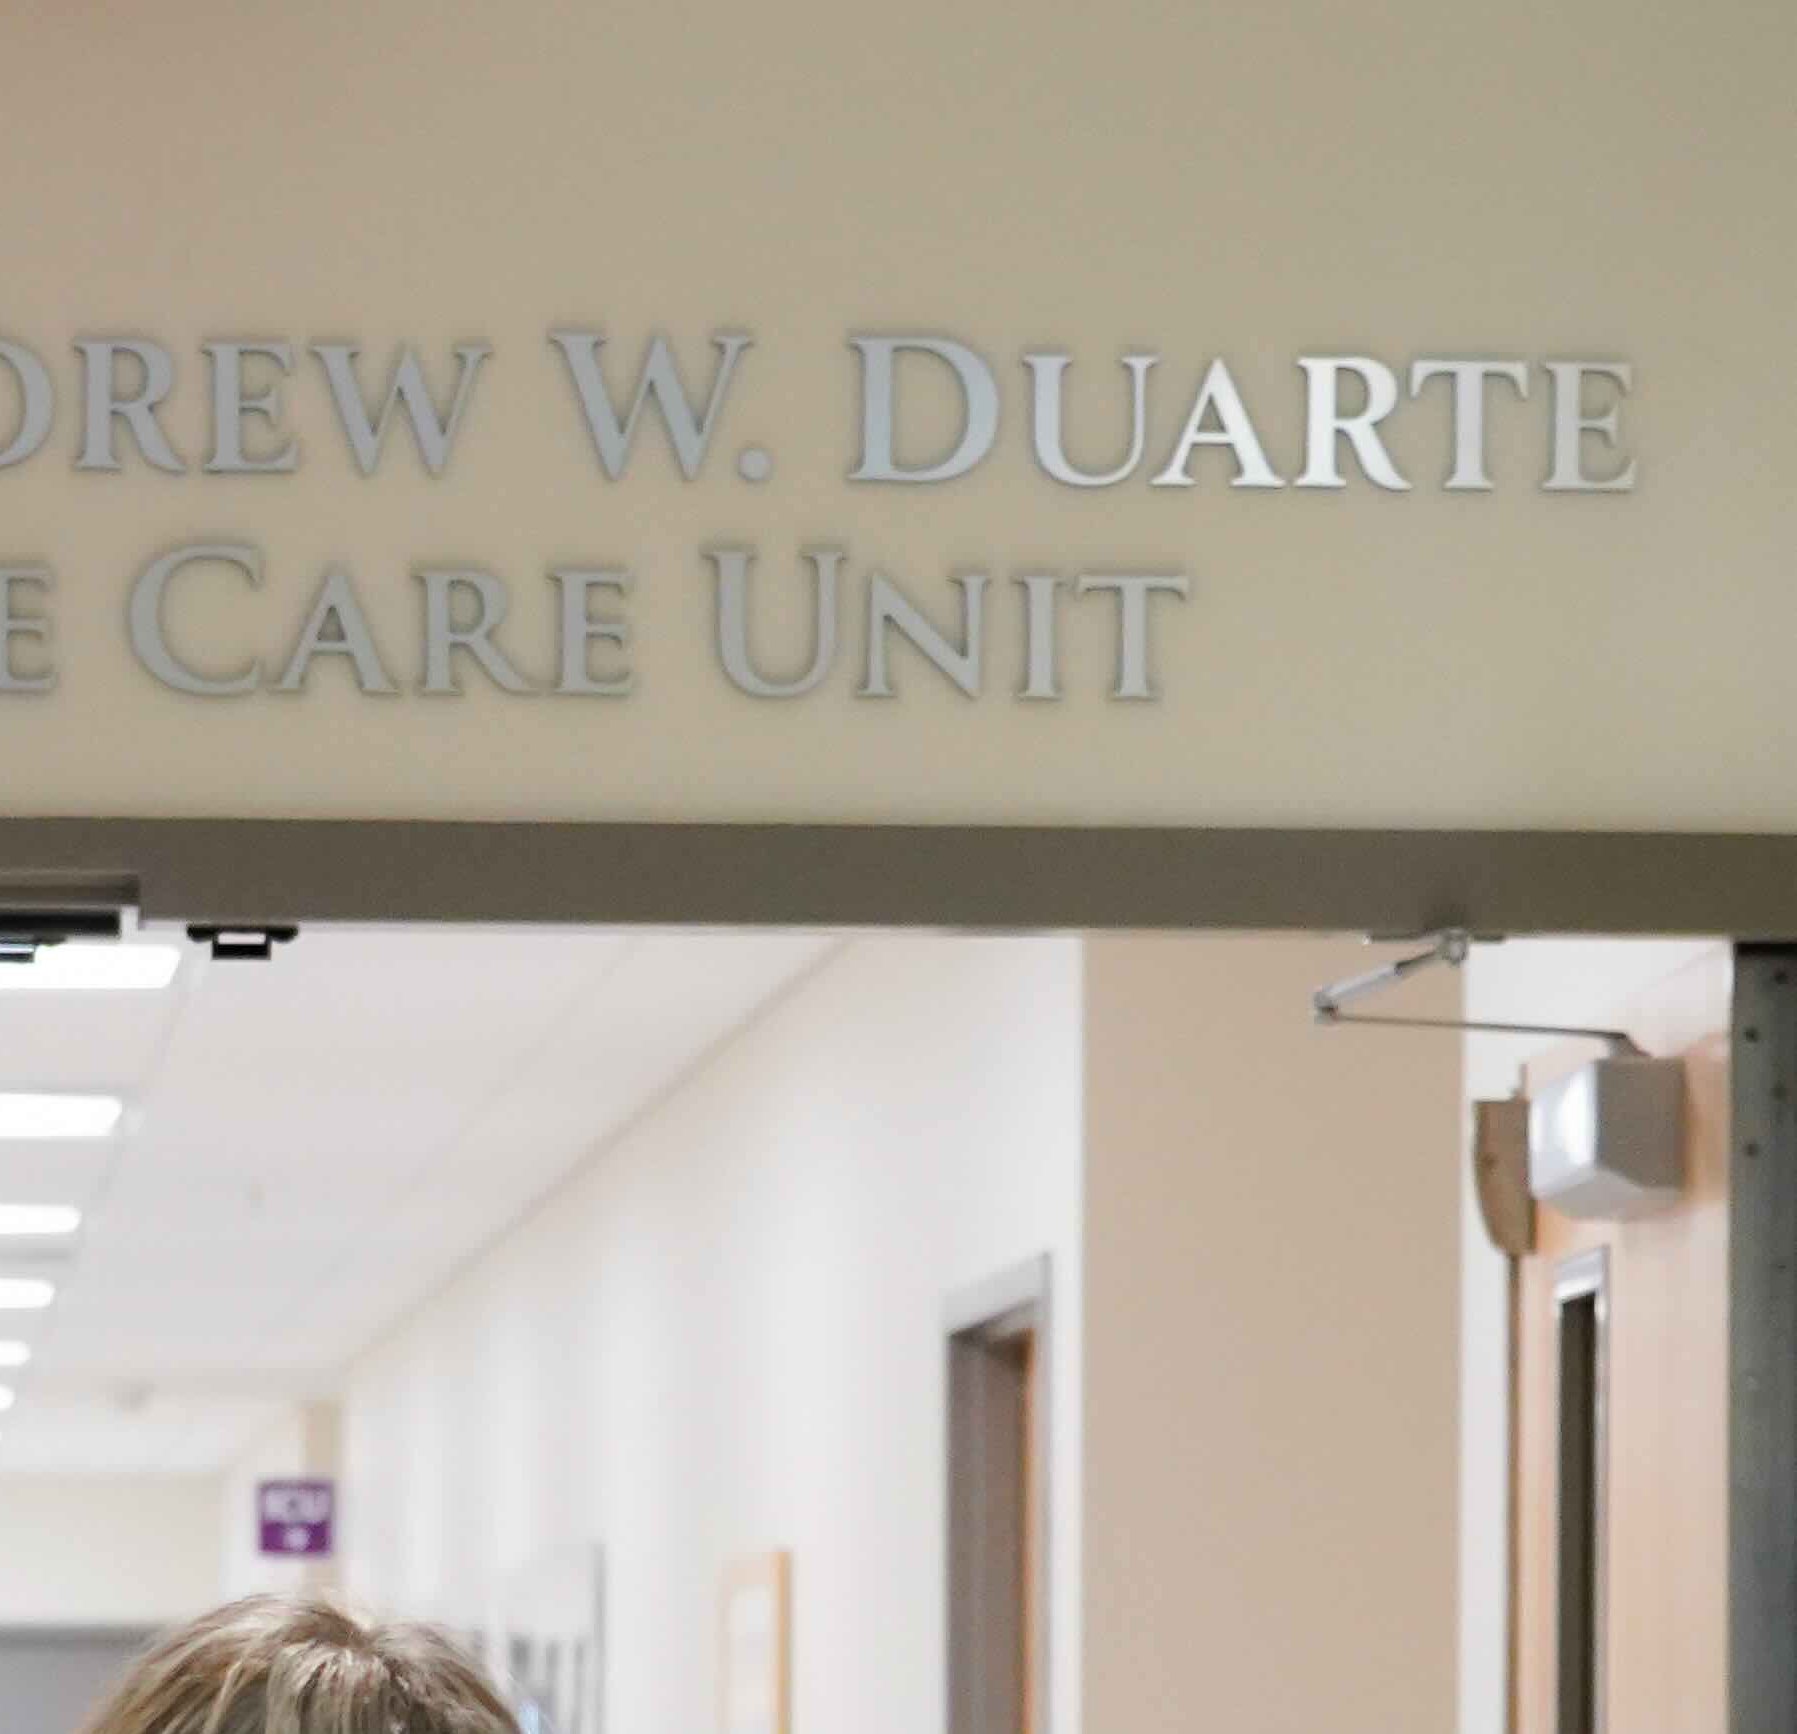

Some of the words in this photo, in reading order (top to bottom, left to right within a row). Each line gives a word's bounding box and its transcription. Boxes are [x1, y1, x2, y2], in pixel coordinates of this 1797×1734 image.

[546, 328, 772, 482] W.
[847, 333, 1638, 494] DUARTE
[124, 544, 633, 697] CARE
[703, 546, 1190, 702] UNIT
